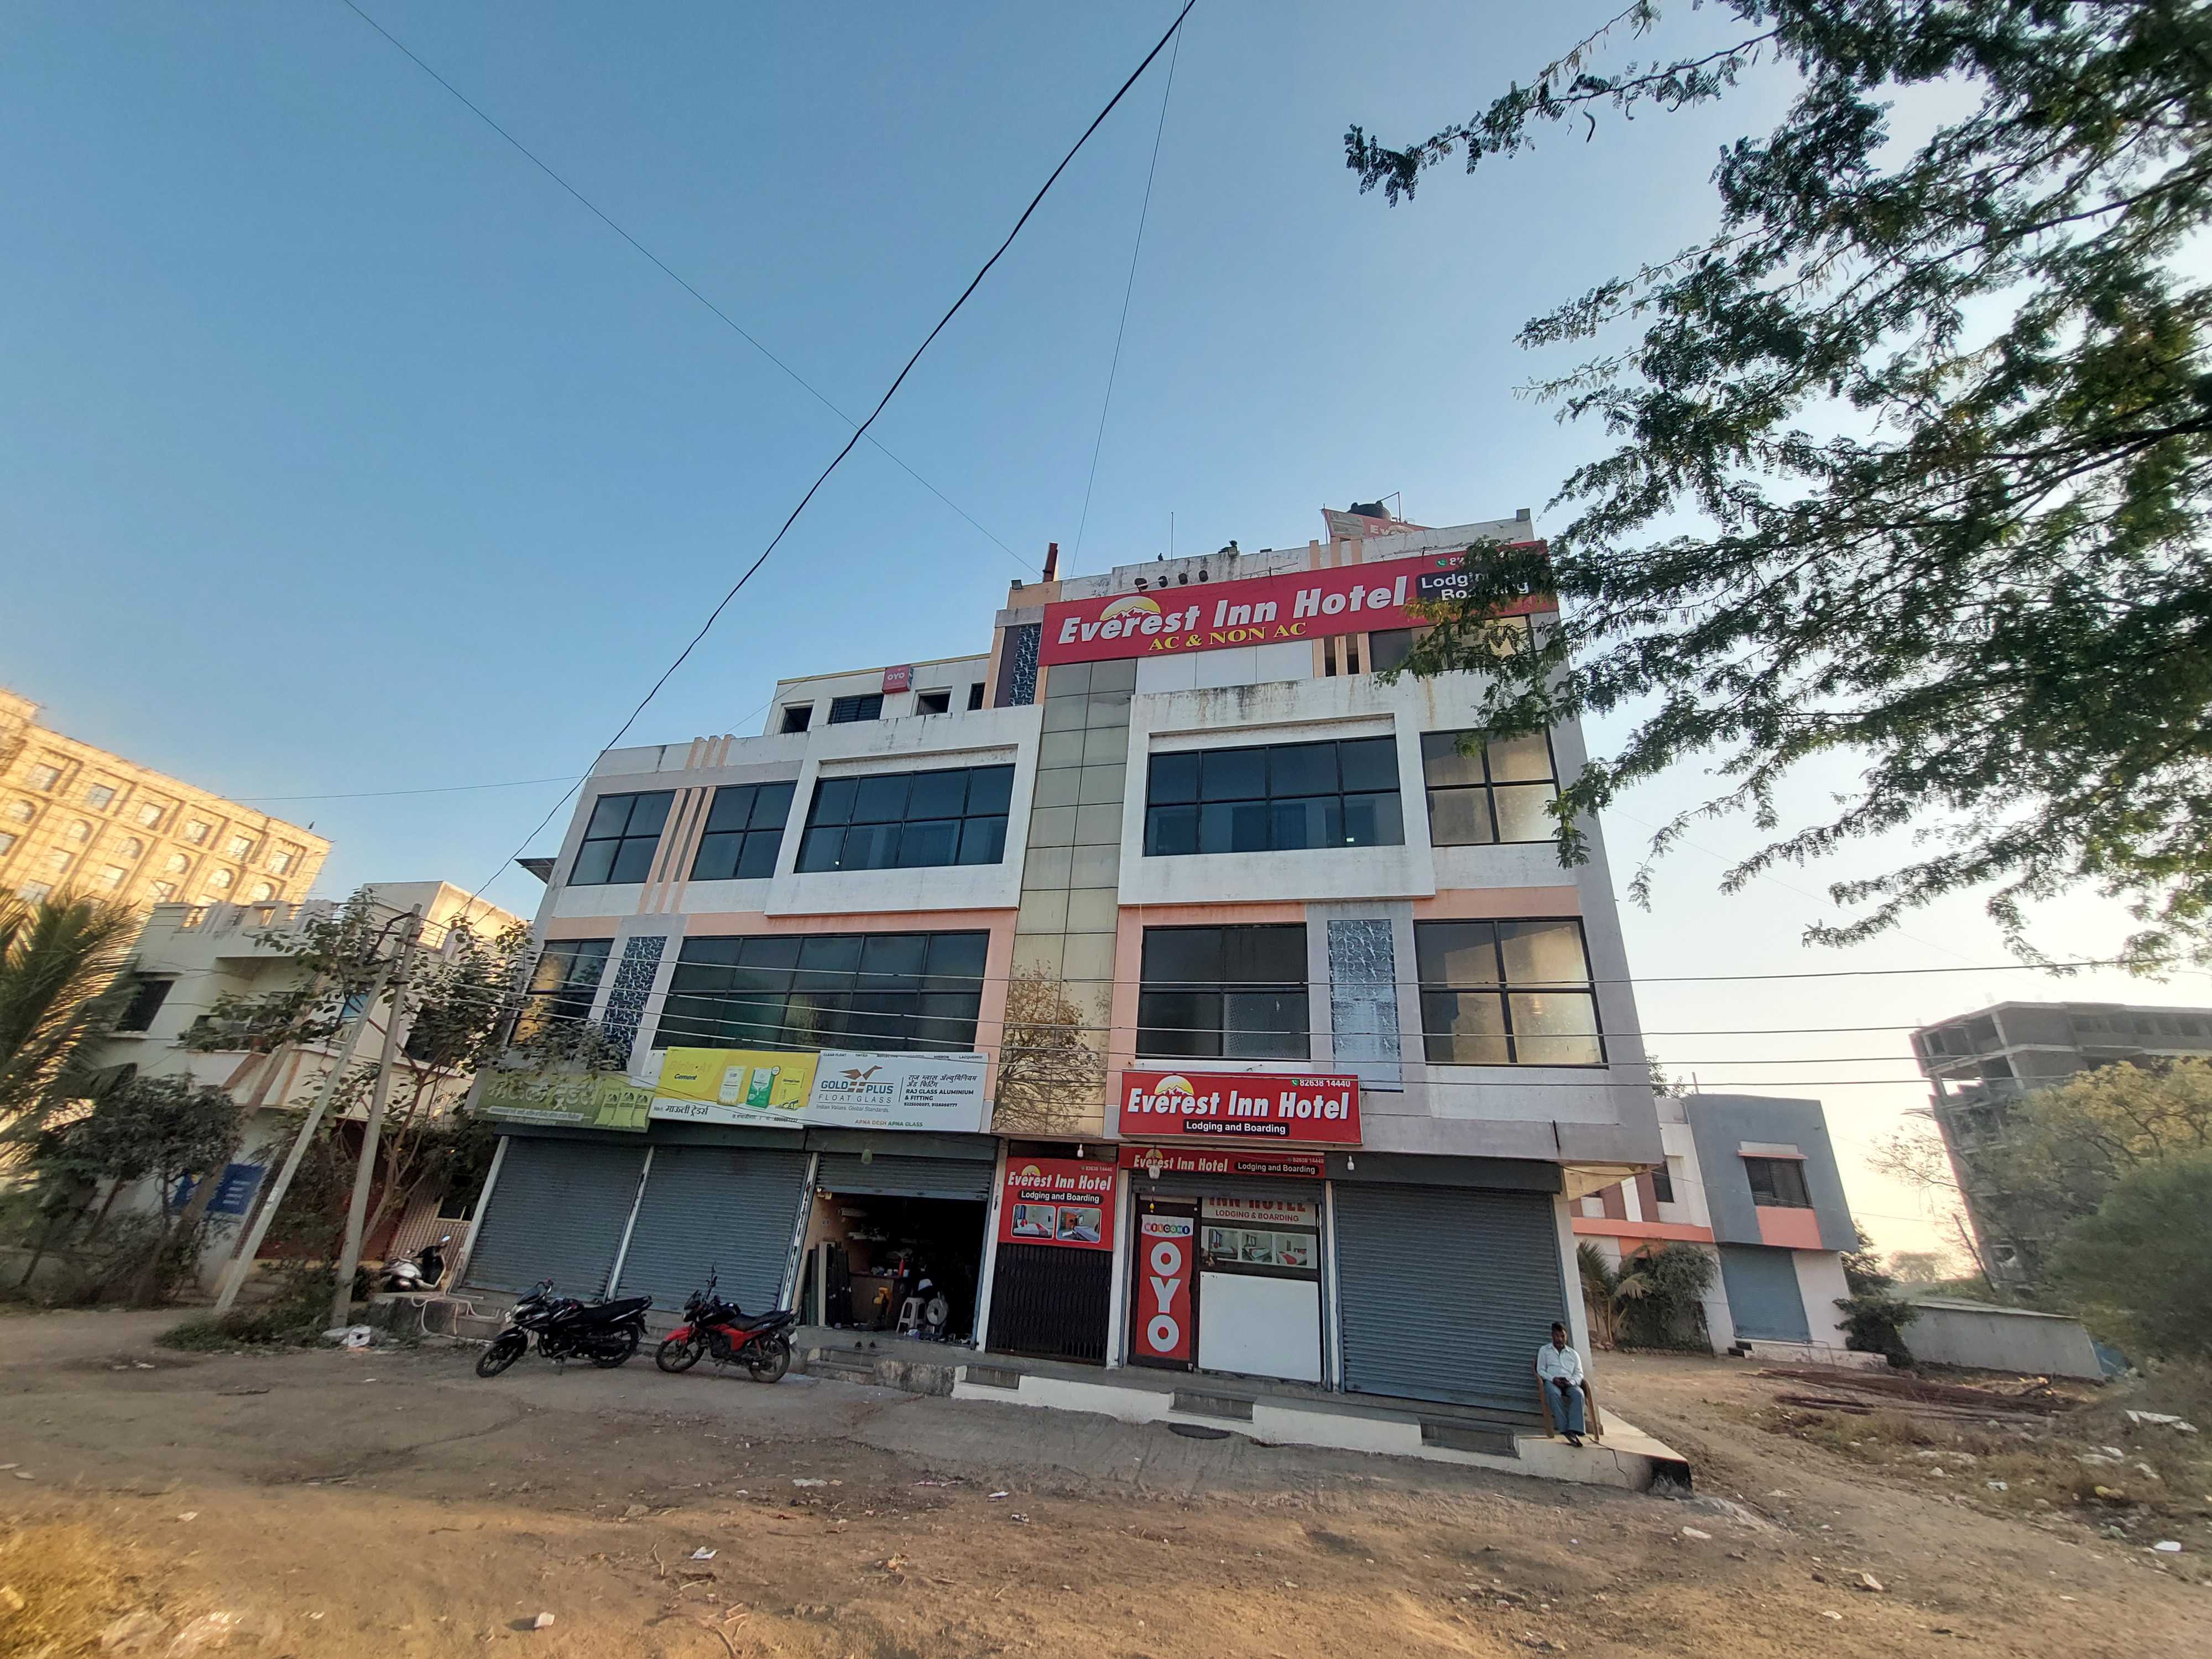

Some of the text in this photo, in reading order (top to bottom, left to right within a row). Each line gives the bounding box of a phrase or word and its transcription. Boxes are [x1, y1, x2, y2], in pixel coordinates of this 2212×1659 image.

[1058, 576, 1407, 645] Everest Inn Hotel
[1149, 622, 1307, 651] AC & NON AC
[887, 672, 905, 681] OYO
[821, 1081, 894, 1094] GOLD PLUS
[1300, 1079, 1351, 1088] 82638 14440
[1127, 1088, 1350, 1120] Everest Inn Hotel
[1186, 1121, 1286, 1135] Lodging and Boarding
[1134, 1155, 1229, 1172] Everest Inn Hotel
[1238, 1162, 1266, 1172] Lodging
[1283, 1165, 1316, 1175] Boarding
[1007, 1171, 1113, 1191] Everest Inn Hotel
[1021, 1191, 1050, 1201] Lodging
[1066, 1193, 1100, 1204] Boarding
[1215, 1209, 1250, 1219] LODGING
[1258, 1212, 1300, 1222] BOARDING
[1144, 1223, 1191, 1235] WELCOME
[1147, 1241, 1182, 1353] OYO
